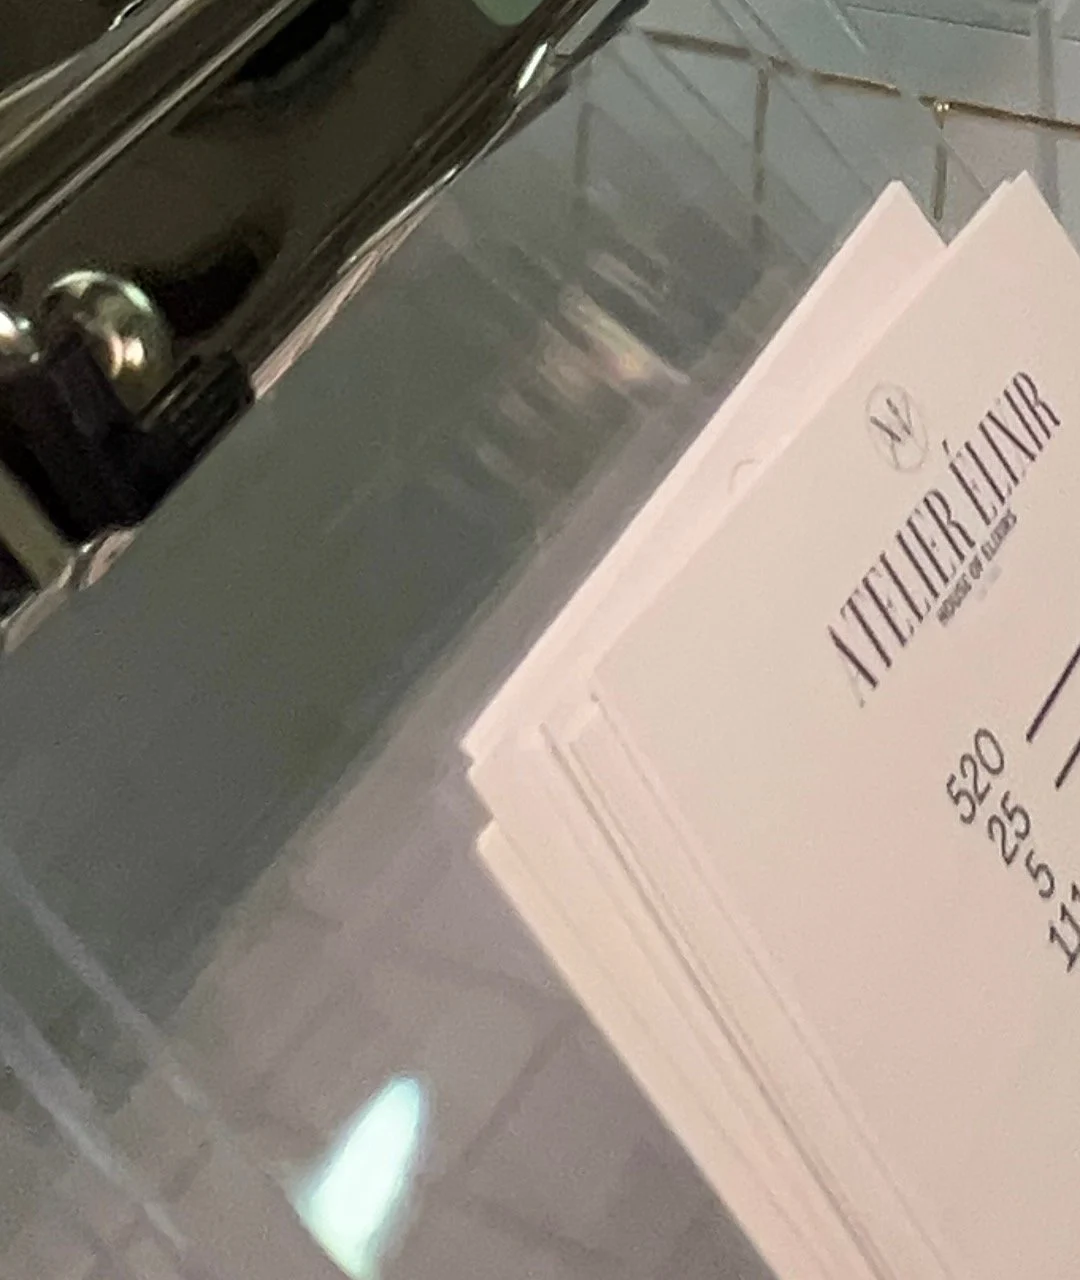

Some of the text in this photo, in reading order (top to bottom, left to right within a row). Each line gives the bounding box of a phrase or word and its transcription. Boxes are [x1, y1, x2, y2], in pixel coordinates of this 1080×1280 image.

[826, 489, 977, 708] ATELIER
[941, 370, 1061, 527] ÉLIXIR
[938, 572, 972, 627] HOUSE
[968, 554, 984, 580] OF
[946, 728, 1005, 825] 520
[987, 790, 1031, 866] 25
[1025, 848, 1056, 899] 5
